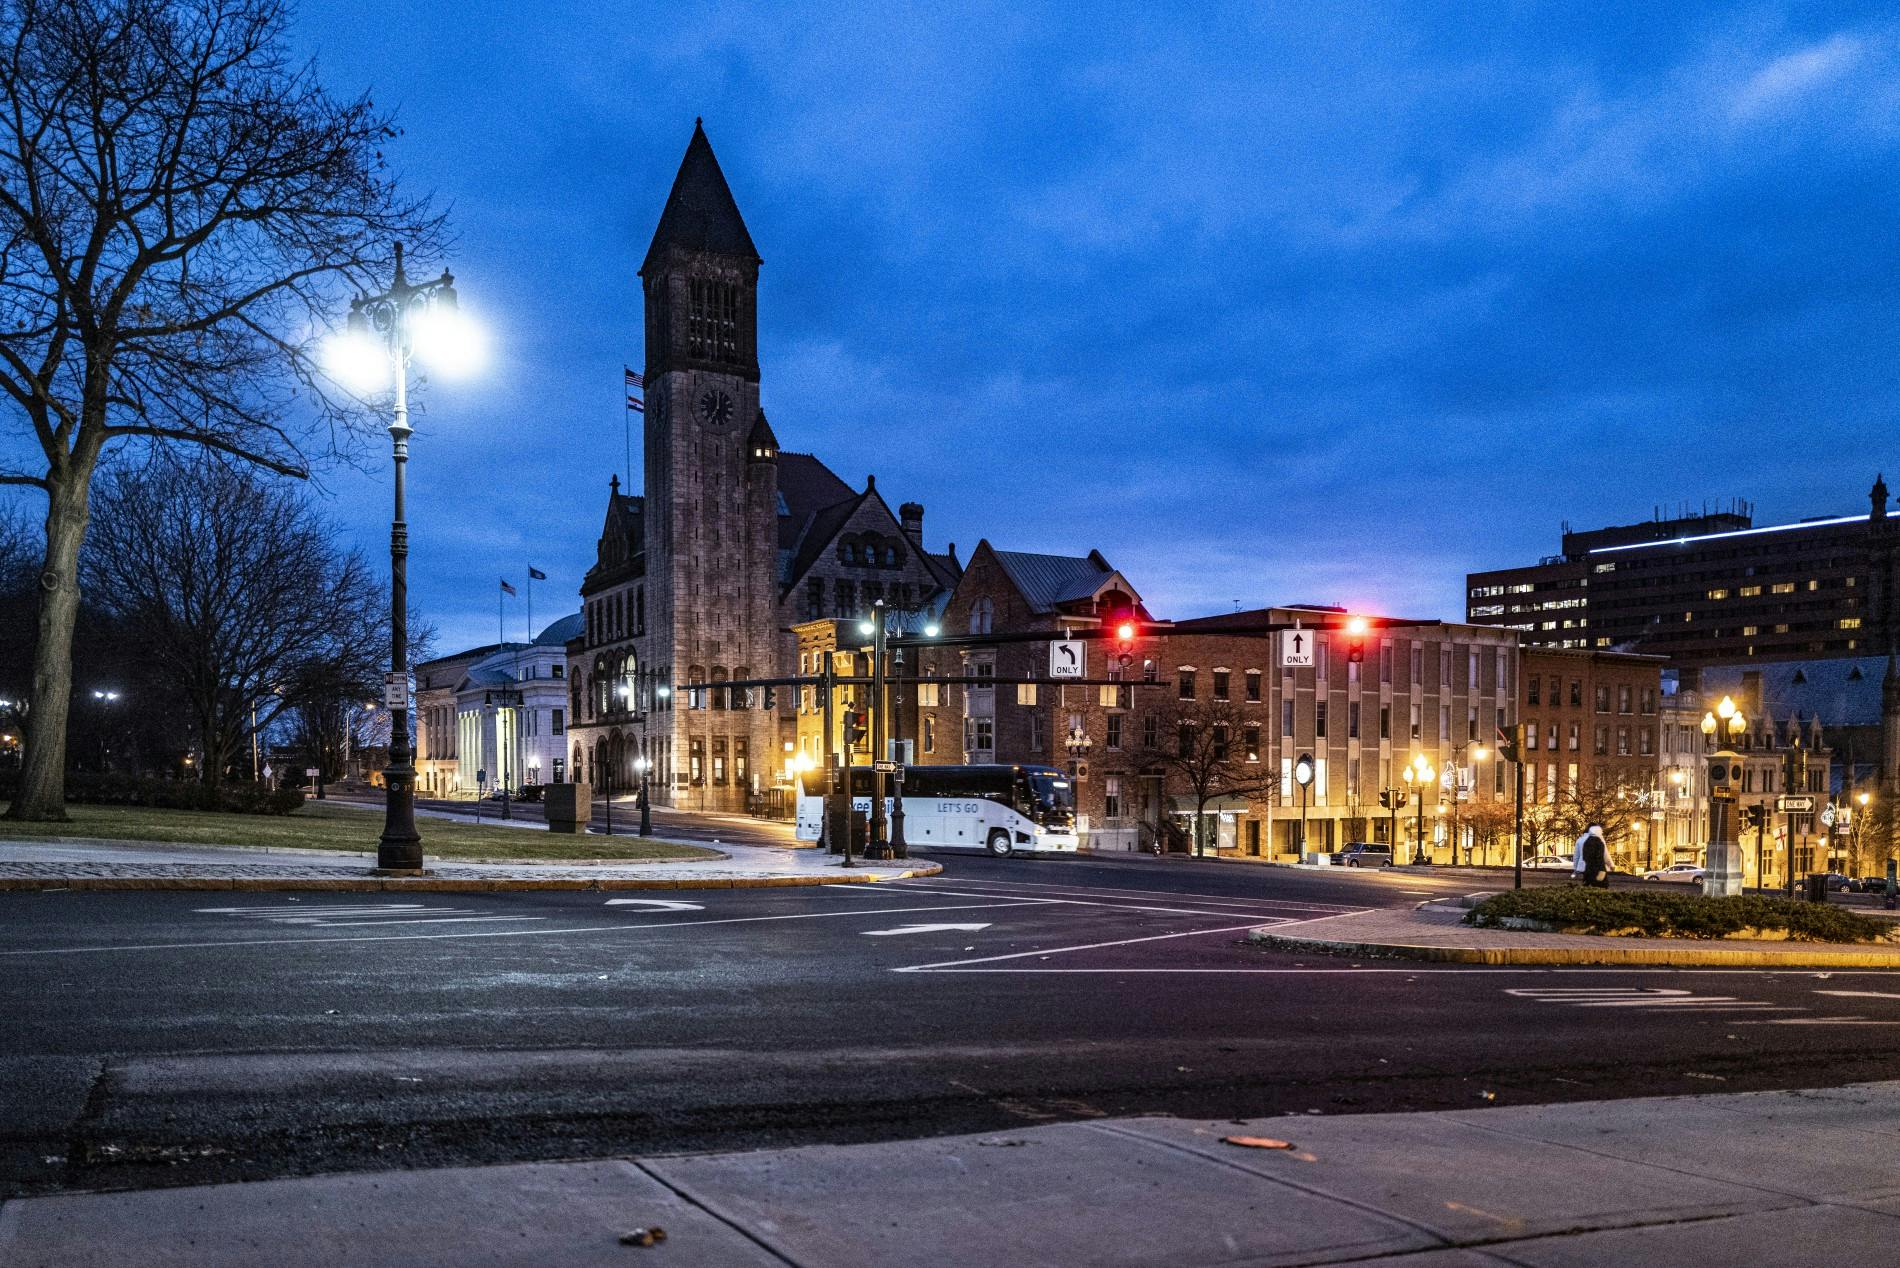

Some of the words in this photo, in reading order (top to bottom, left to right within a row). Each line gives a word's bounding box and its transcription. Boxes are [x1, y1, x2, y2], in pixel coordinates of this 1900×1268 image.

[1287, 655, 1309, 664] ONLY
[1056, 666, 1078, 674] ONLY
[937, 802, 961, 813] LET'S
[964, 803, 978, 813] GO
[1787, 800, 1795, 808] ONE
[1796, 800, 1805, 808] WAY
